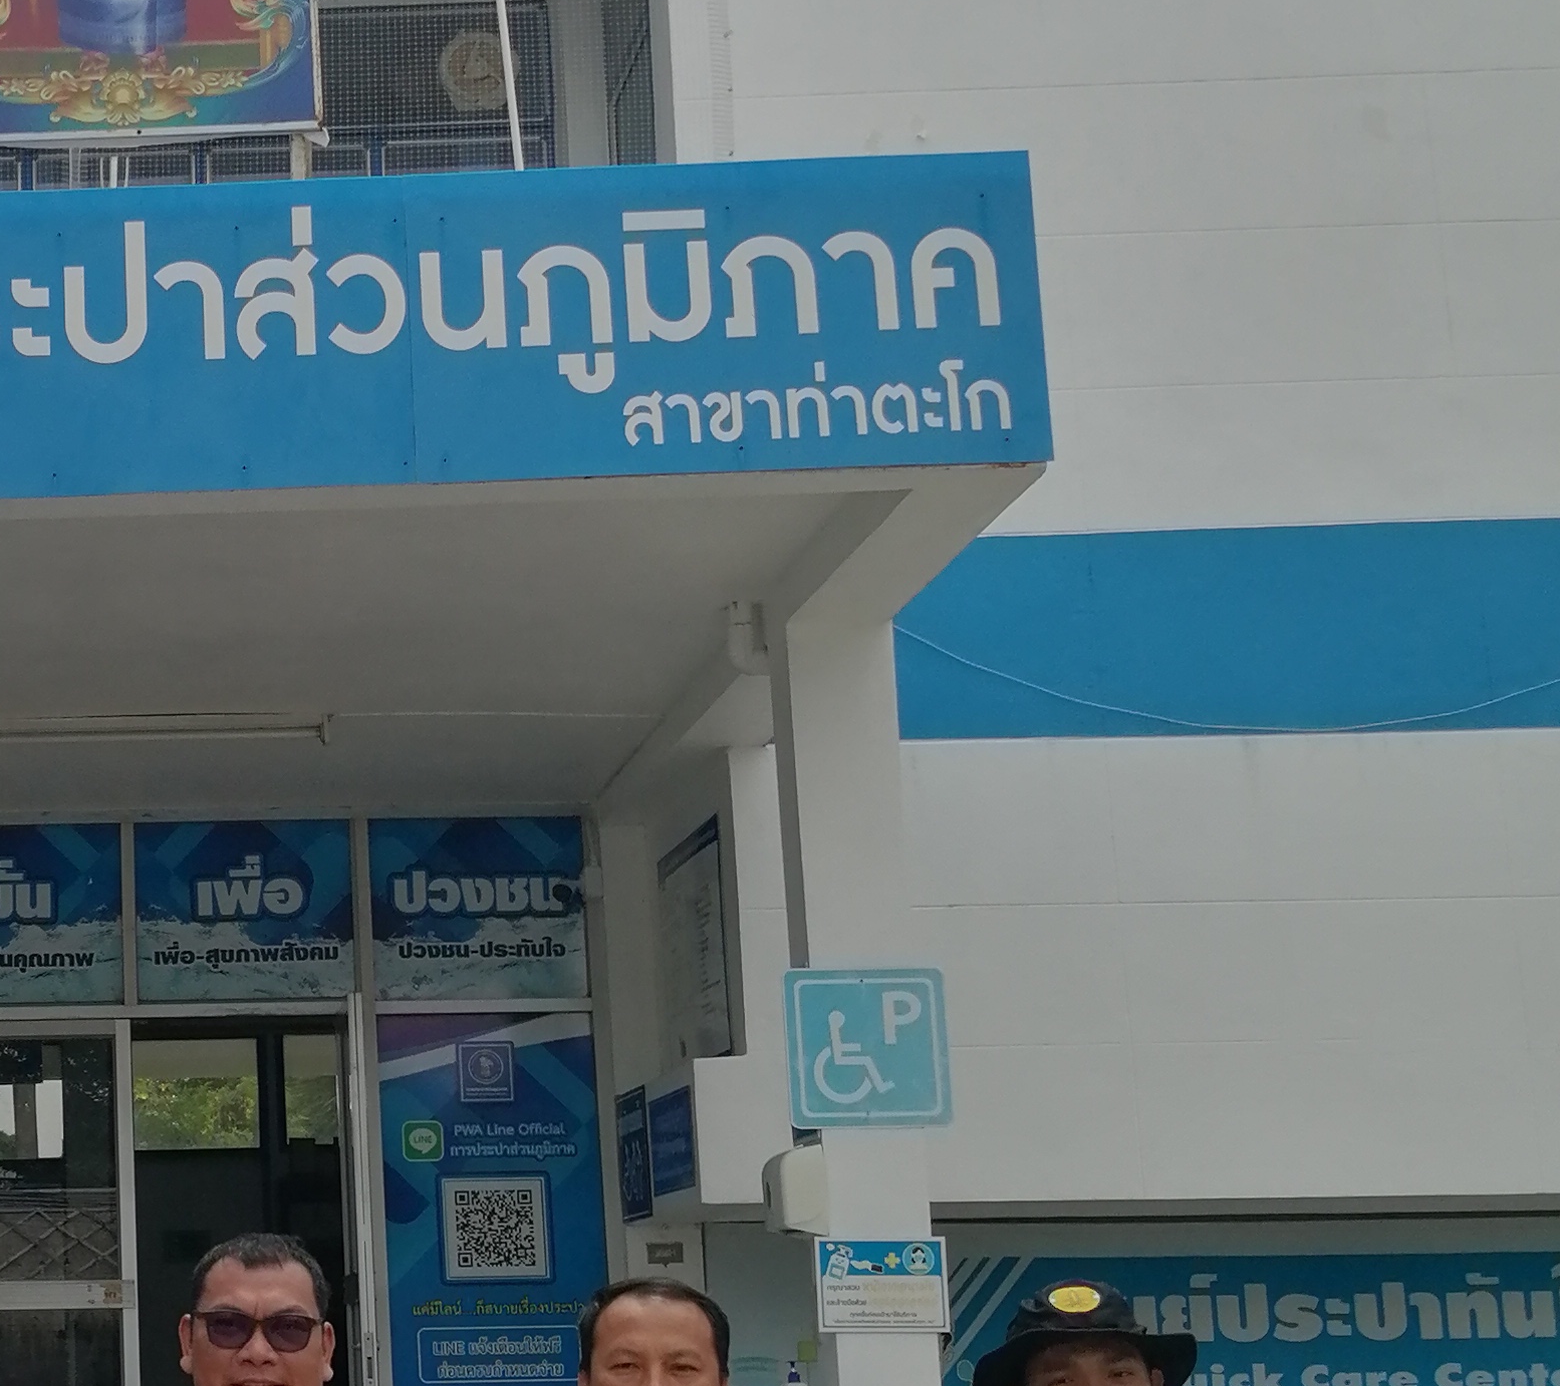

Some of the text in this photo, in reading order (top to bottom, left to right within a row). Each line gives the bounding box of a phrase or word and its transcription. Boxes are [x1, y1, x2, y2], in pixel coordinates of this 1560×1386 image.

[623, 360, 1012, 446] สาขาท่าตะโก
[196, 855, 303, 917] เพื่อ
[154, 941, 339, 971] เพื่อ-สุขภาพสังคม
[399, 936, 566, 960] ปวงชน-ประทับใจ
[882, 990, 922, 1045] P
[413, 1135, 433, 1144] LINE
[454, 1122, 566, 1136] PWA Line Official
[450, 1141, 576, 1159] การประปาส่วนภูมิภาค
[432, 1340, 465, 1357] LINE
